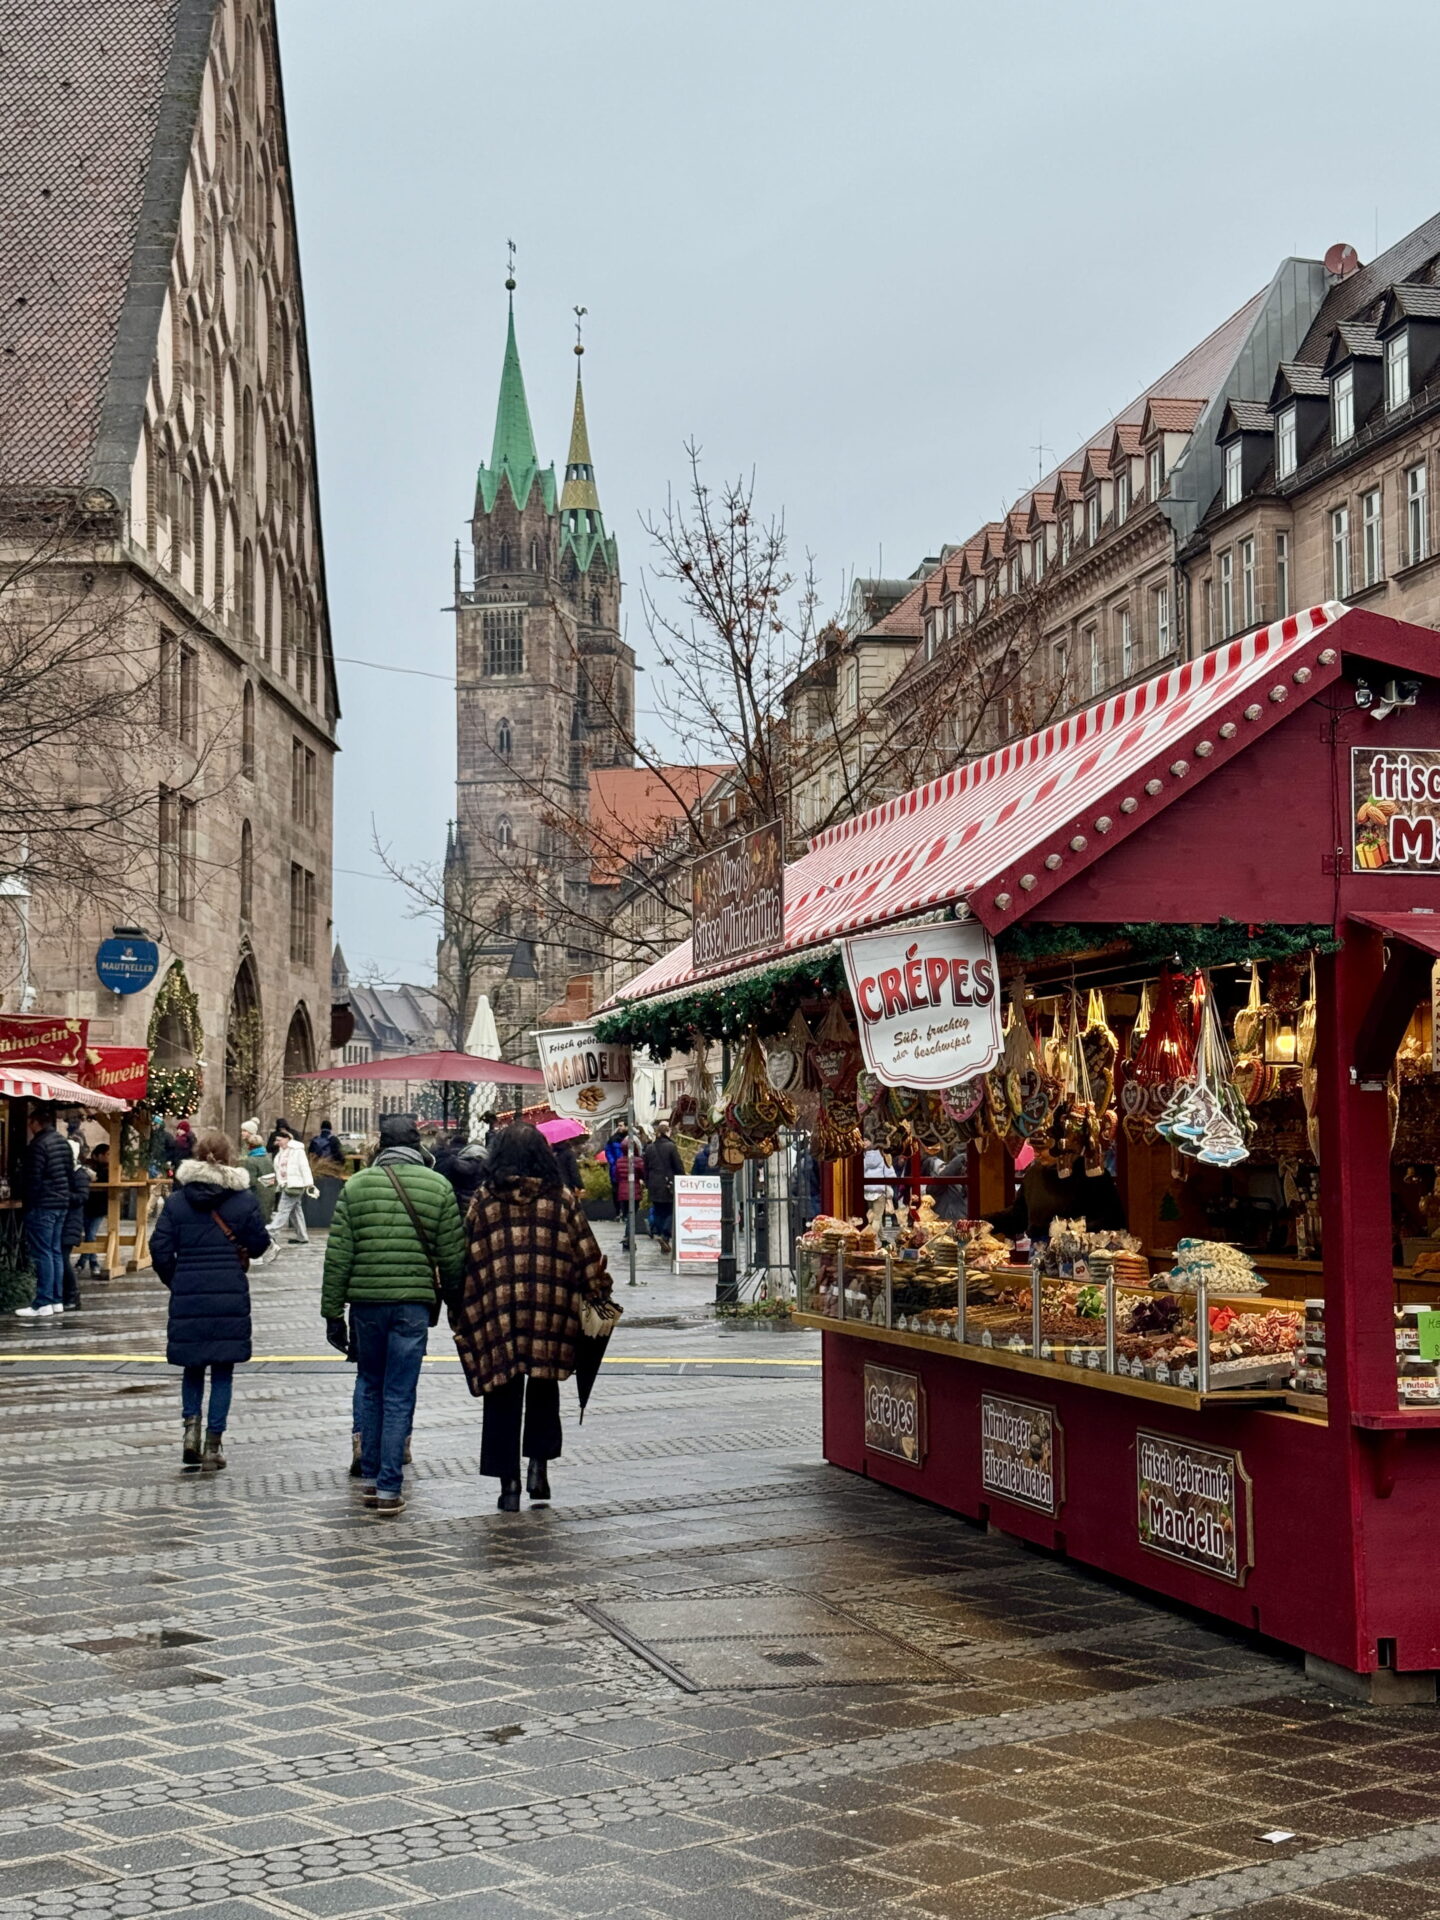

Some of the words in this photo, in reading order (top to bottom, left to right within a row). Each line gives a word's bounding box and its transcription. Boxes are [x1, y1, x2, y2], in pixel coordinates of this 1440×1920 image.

[1369, 754, 1440, 803] frisc
[1389, 815, 1440, 863] M
[101, 962, 154, 973] MAUTKELLER
[857, 942, 995, 1025] CRÉPES
[0, 1027, 69, 1053] ühwein
[549, 1039, 575, 1053] Frisch
[892, 1049, 909, 1063] oder
[914, 1034, 971, 1059] beschwipst
[893, 1027, 922, 1047] Süß,
[926, 1017, 970, 1041] fruchtig
[545, 1051, 631, 1093] MANDELN
[679, 1180, 720, 1190] CityTou
[1406, 1381, 1434, 1389] nutella
[869, 1384, 914, 1437] Crêpes
[983, 1403, 1031, 1455] Nürnberger
[984, 1449, 1052, 1504] Elisenlebkuchen
[1141, 1442, 1172, 1487] frisch
[1173, 1455, 1230, 1504] gebrannte
[1150, 1496, 1226, 1559] Mandeln
